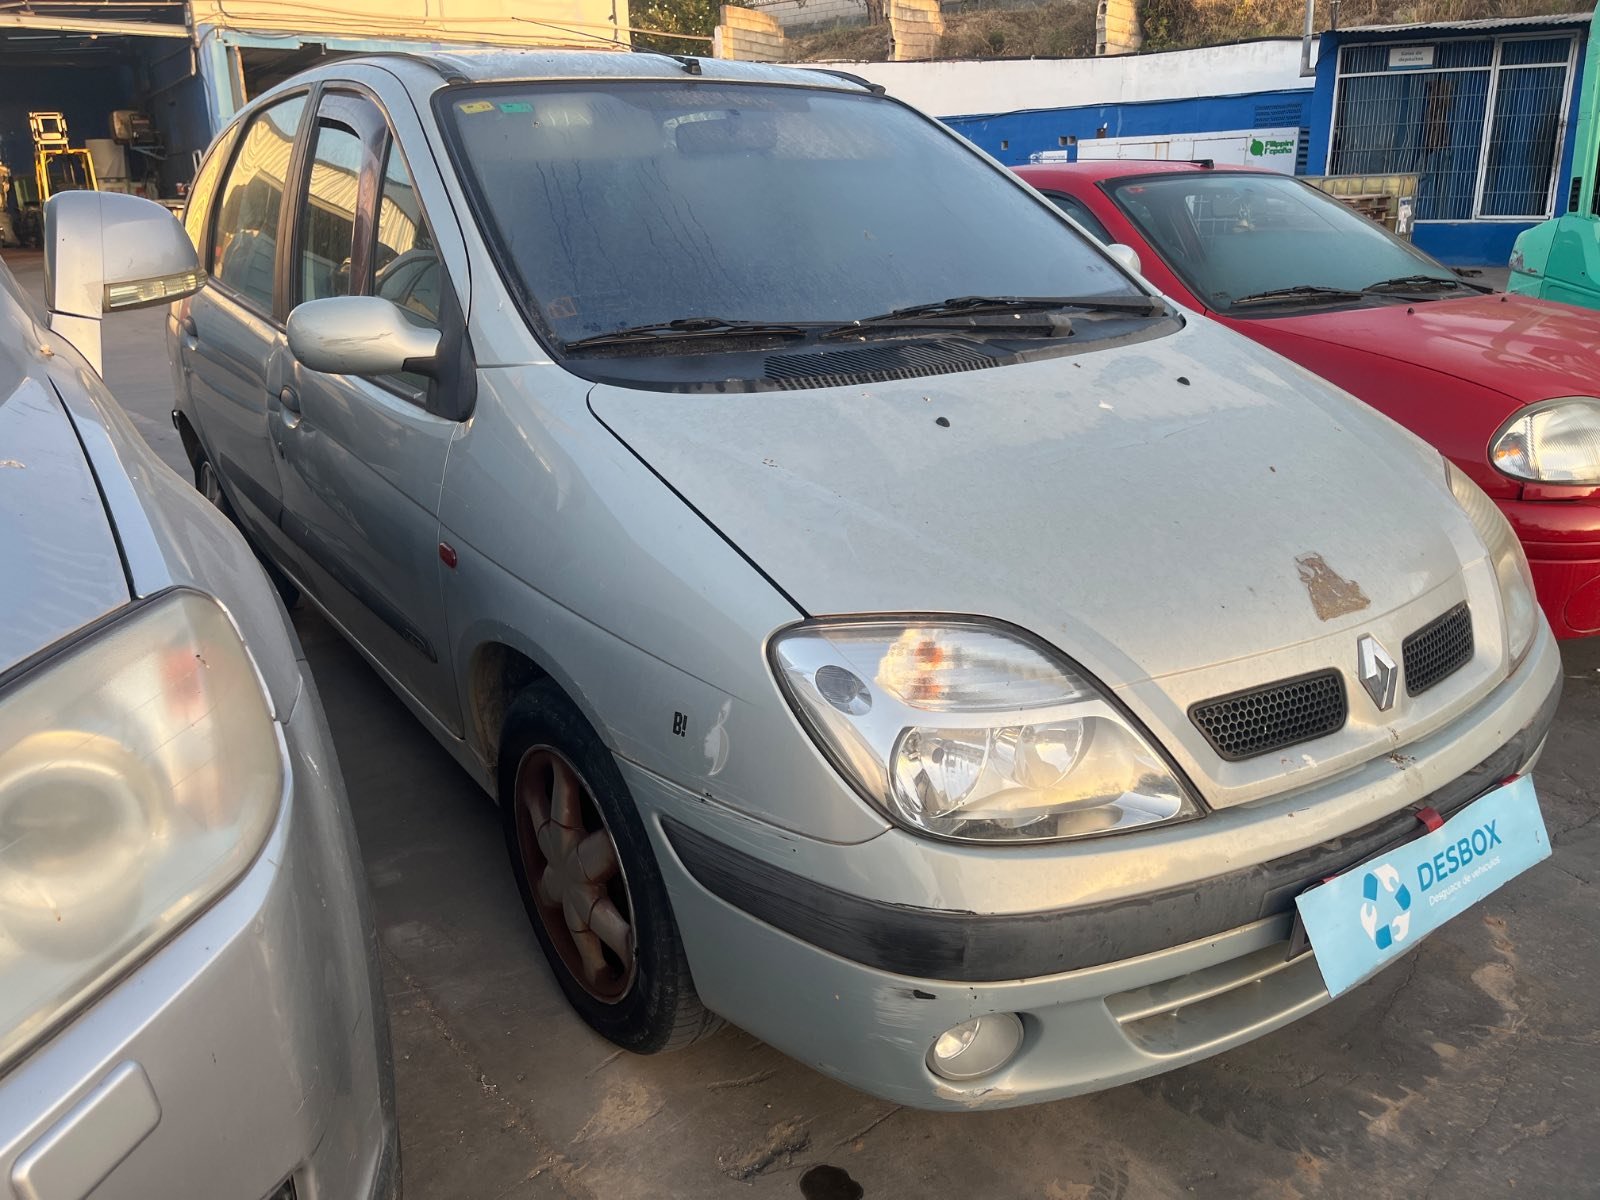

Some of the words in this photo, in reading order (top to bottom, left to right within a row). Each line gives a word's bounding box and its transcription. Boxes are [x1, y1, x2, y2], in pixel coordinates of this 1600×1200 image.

[1416, 818, 1502, 892] DESBOX
[1429, 881, 1462, 906] Desguace
[1462, 874, 1472, 885] de
